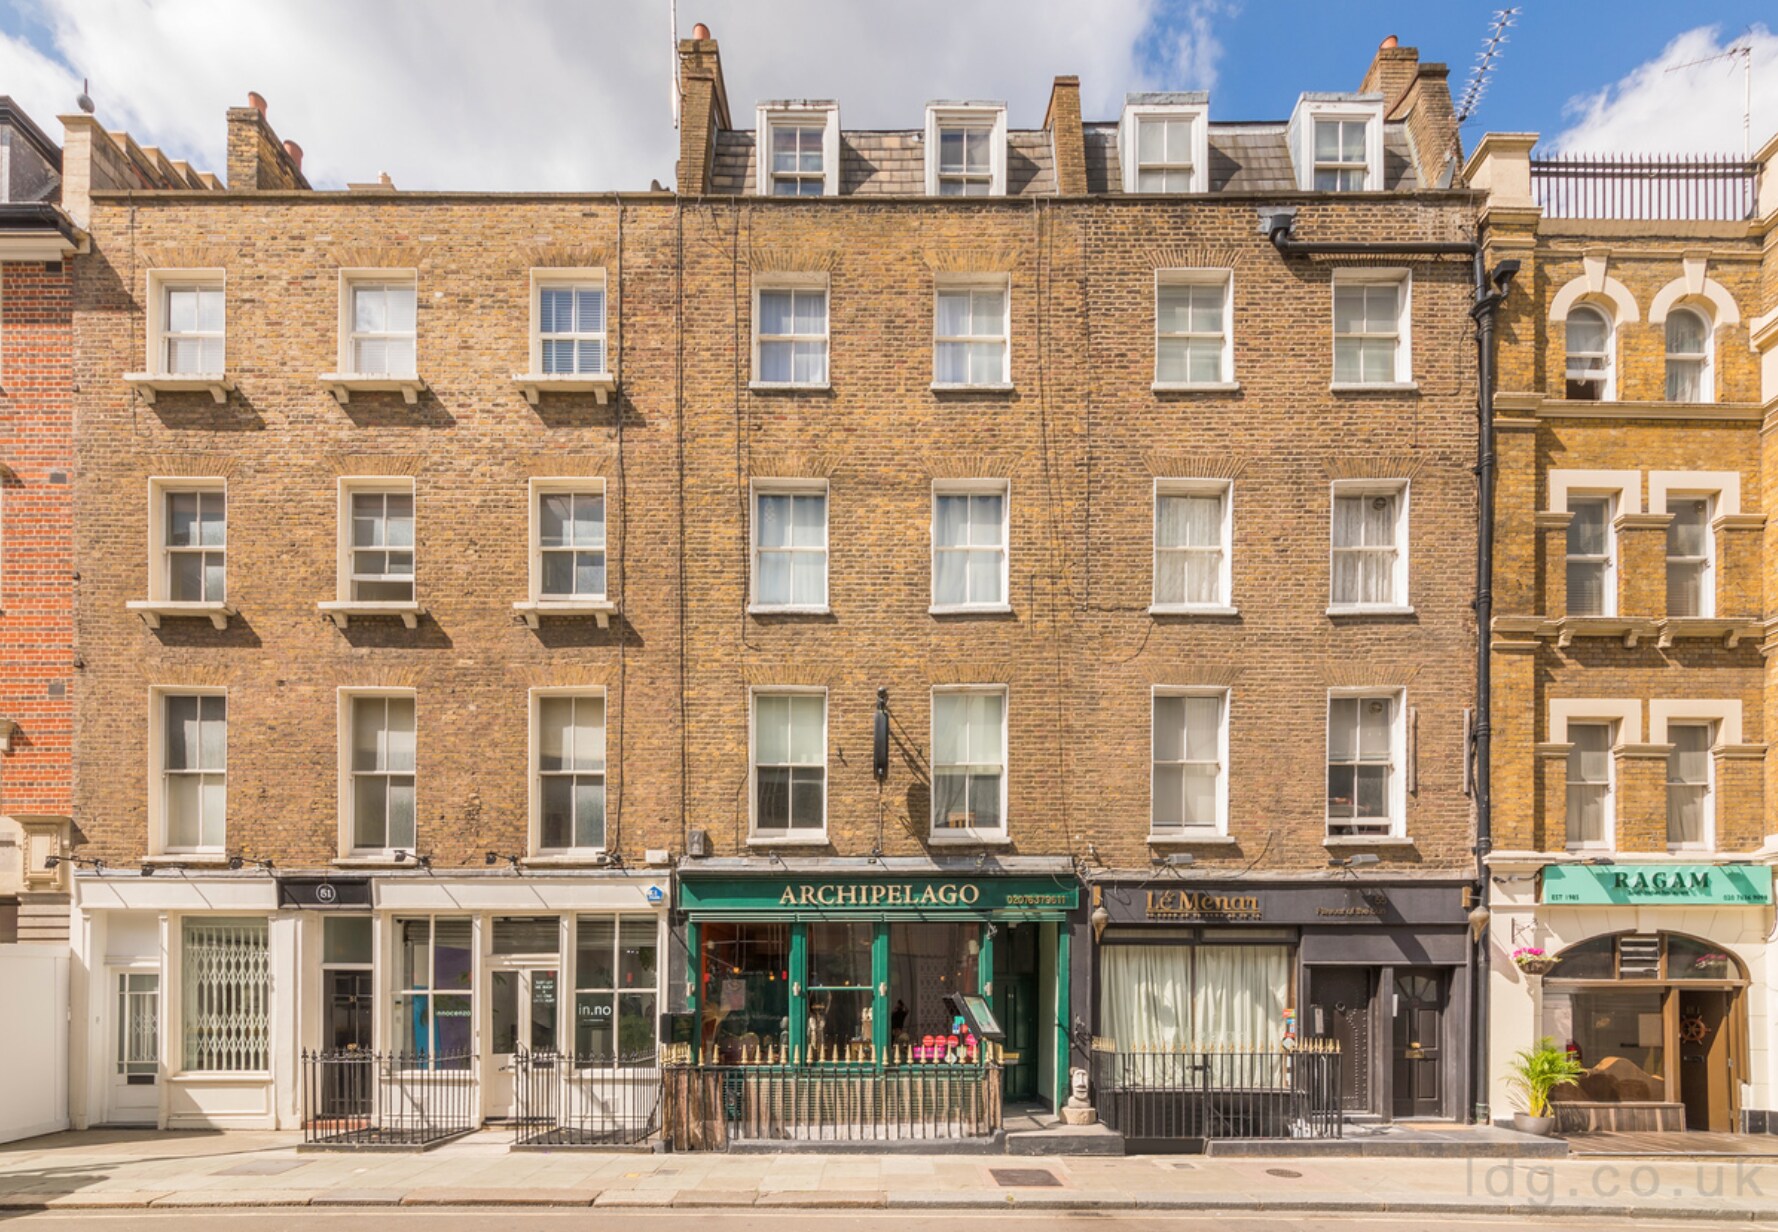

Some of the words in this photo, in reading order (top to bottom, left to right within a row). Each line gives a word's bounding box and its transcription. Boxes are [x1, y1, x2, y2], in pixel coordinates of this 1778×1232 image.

[1614, 871, 1709, 888] RAGAM
[320, 888, 332, 898] 51
[779, 884, 980, 905] ARCHIPELAGO
[578, 1003, 612, 1016] in.no
